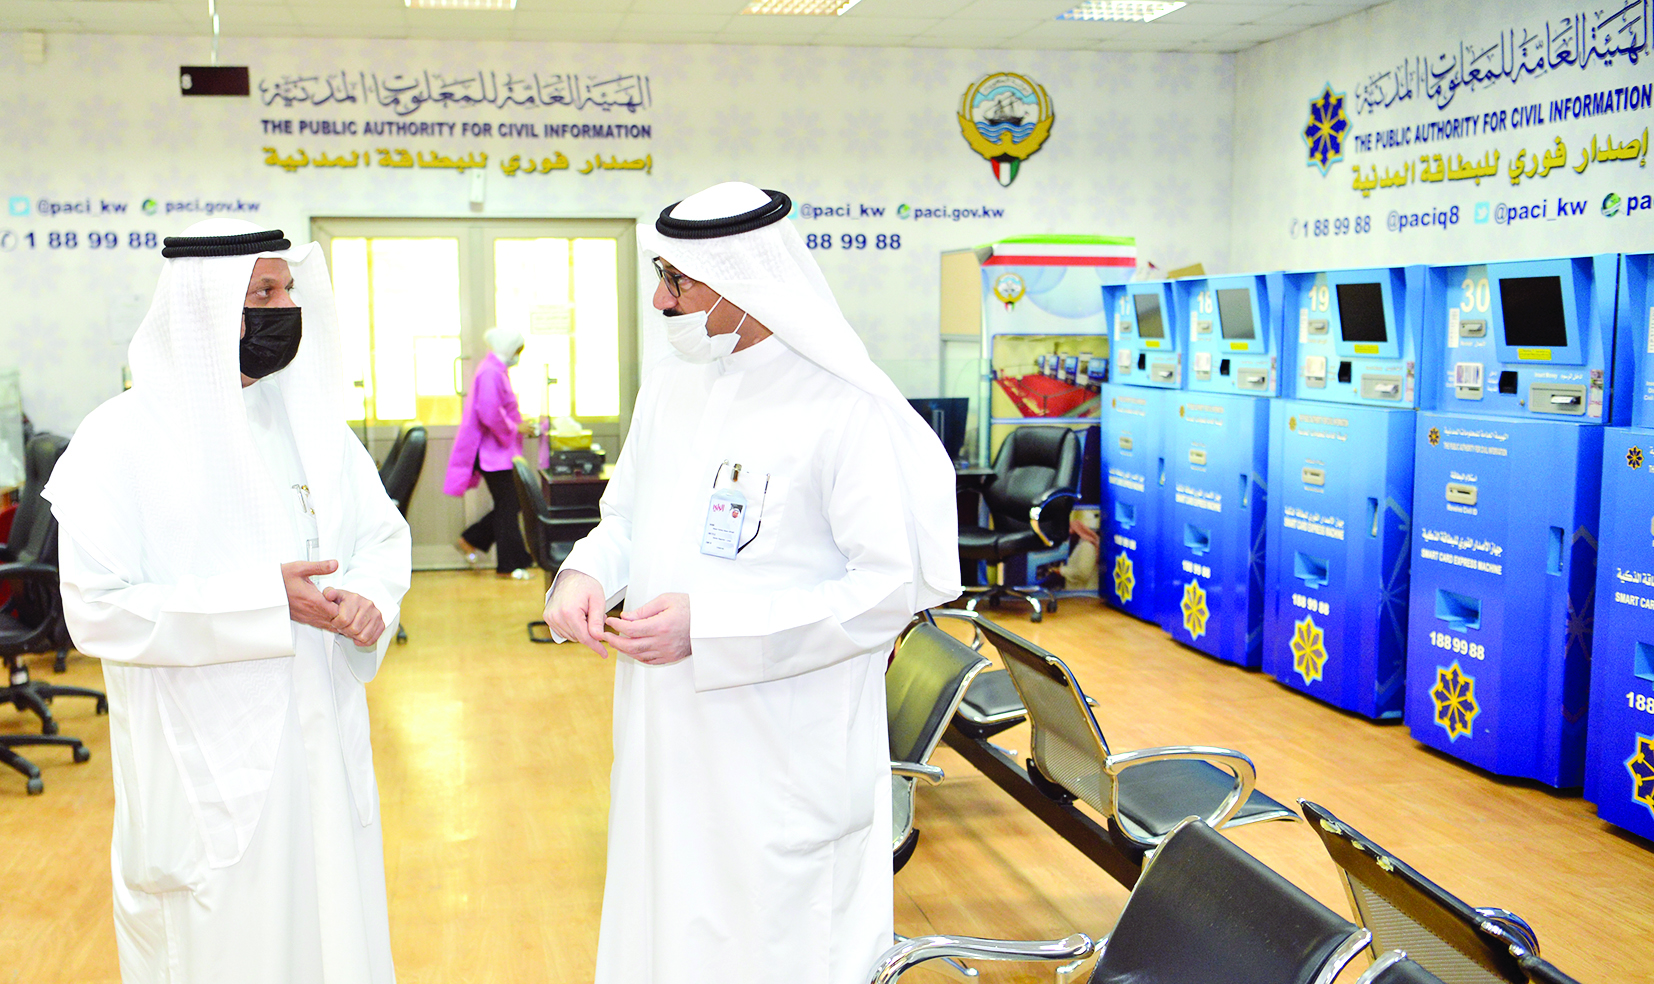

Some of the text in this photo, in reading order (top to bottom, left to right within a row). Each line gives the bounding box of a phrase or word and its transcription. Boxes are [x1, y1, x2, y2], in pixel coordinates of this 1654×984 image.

[261, 119, 651, 138] THE PUBLIC AUTHORITY FOR CIVIL INFORMATION
[1354, 83, 1653, 153] THE PUBLIC AUTHORITY FOR CIVIL INFORMATION
[262, 146, 652, 176] إصدار فوري للبطاقة المدنية
[1351, 127, 1649, 198] إصدار فوري للبطاقة المدنية
[38, 199, 128, 216] @paci_kw
[165, 199, 260, 215] paci.gov.kw
[801, 203, 886, 220] @paci_kw
[914, 205, 1004, 221] paci.gov.kw
[1494, 198, 1588, 226] @paci_kw
[1314, 219, 1330, 237] 88
[1334, 217, 1350, 235] 99
[1354, 215, 1371, 234] 88
[1387, 205, 1460, 232] @paciq8
[25, 232, 158, 248] 1 88 99 88
[806, 233, 902, 250] 88 99 88
[1309, 285, 1330, 312] 19
[1460, 278, 1491, 313] 30
[1421, 548, 1439, 561] SMART
[1439, 552, 1454, 564] CARD
[1615, 591, 1639, 606] SMART
[1429, 631, 1485, 661] 188 99 88
[1626, 691, 1654, 714] 188
